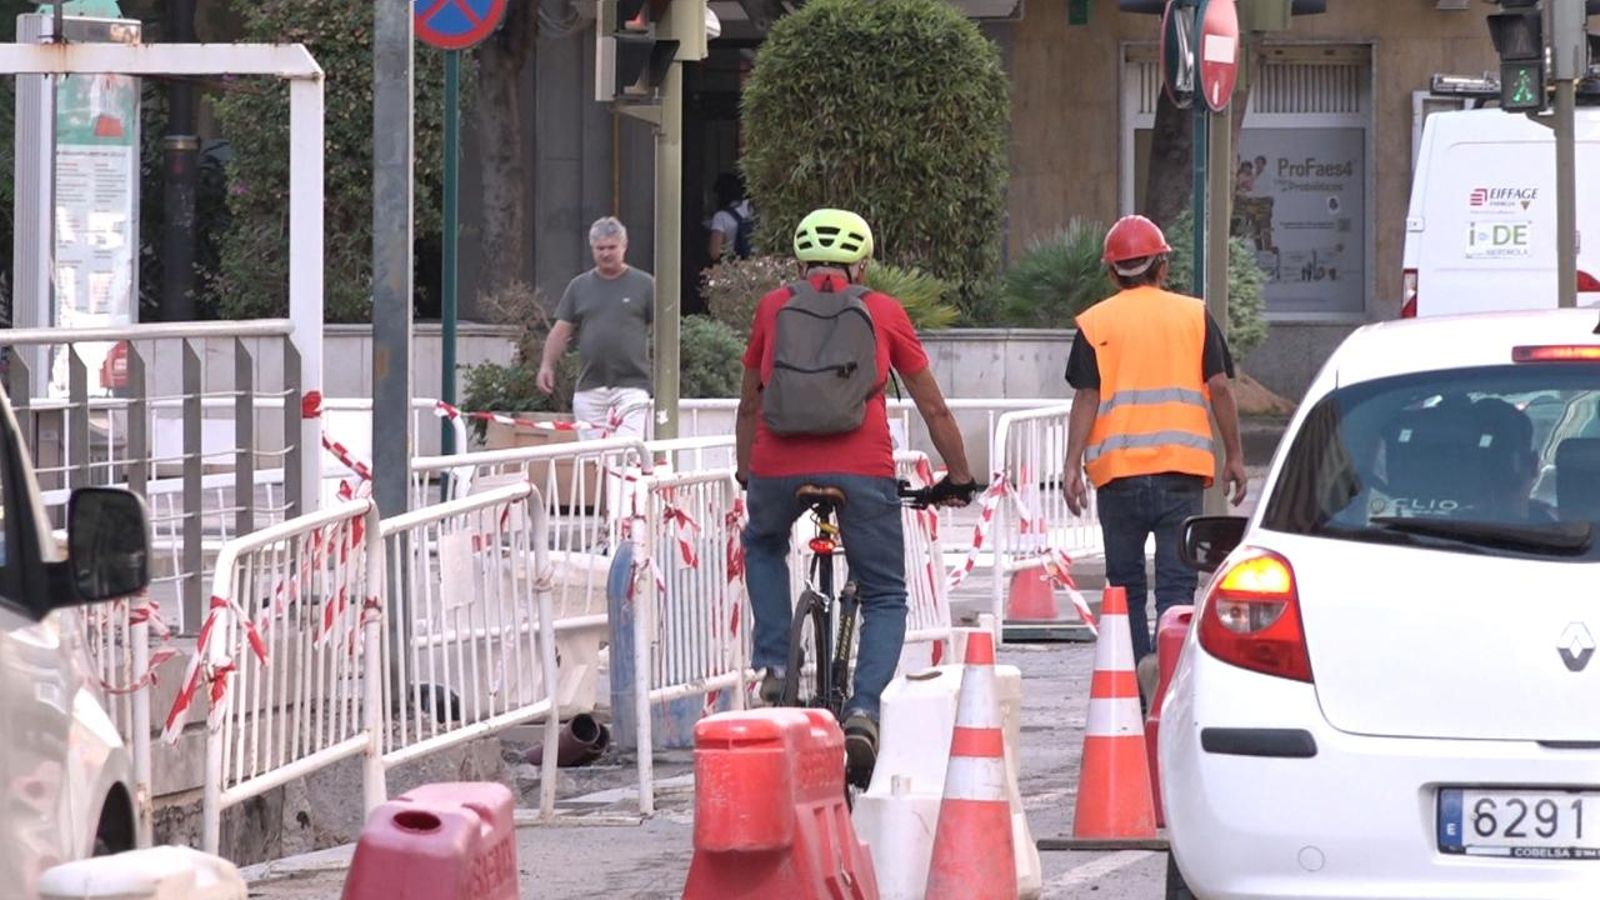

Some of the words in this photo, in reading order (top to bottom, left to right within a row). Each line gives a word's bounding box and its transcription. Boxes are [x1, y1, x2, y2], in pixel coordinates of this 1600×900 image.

[1277, 158, 1353, 177] ProFaes4
[1489, 188, 1539, 200] EIFFAGE
[1473, 798, 1583, 839] 6291
[1446, 823, 1457, 836] E
